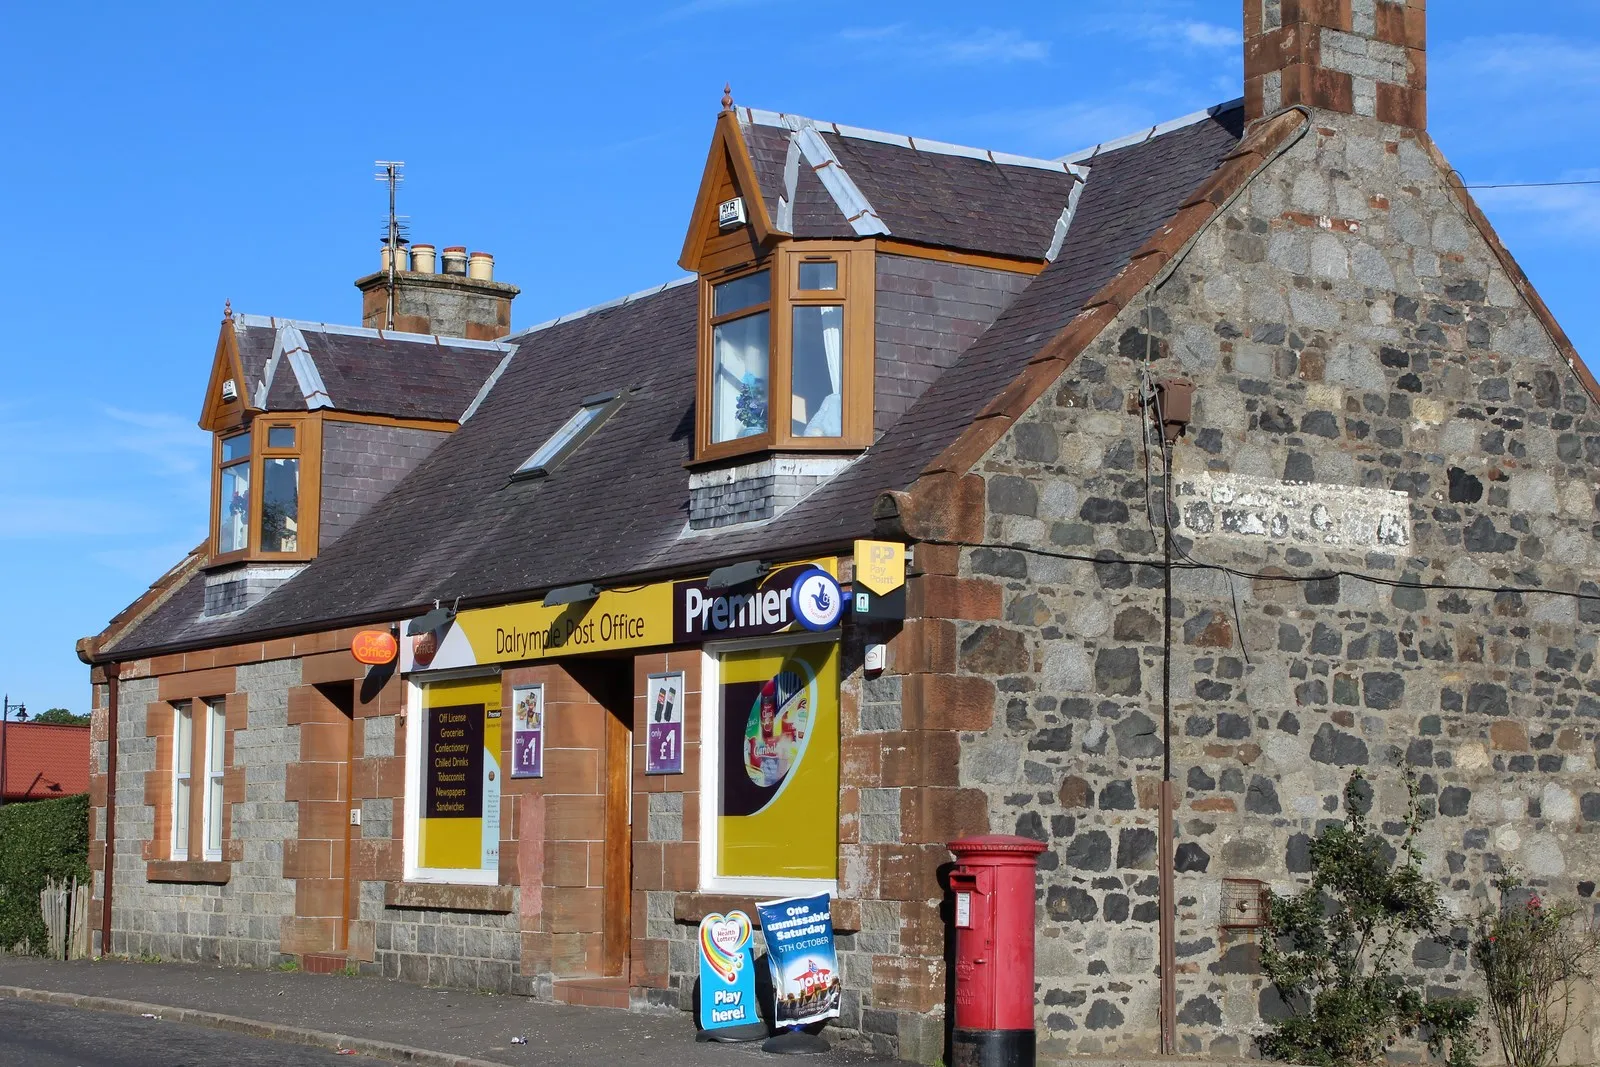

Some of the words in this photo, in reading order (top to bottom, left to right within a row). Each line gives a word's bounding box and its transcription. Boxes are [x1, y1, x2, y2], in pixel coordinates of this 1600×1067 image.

[722, 201, 735, 214] AYR
[686, 587, 792, 633] Premier
[496, 621, 561, 657] Dalrymple
[566, 618, 595, 646] Post
[600, 612, 645, 642] Office
[364, 635, 388, 647] Post
[358, 646, 392, 658] Office
[414, 643, 434, 655] OFFICE
[438, 714, 448, 723] Off
[440, 728, 464, 738] Groceries
[651, 728, 662, 739] only
[515, 735, 525, 747] only
[659, 729, 676, 760] £1
[522, 737, 536, 765] £1
[435, 758, 452, 767] Chilled
[453, 757, 469, 767] Drinks
[437, 772, 465, 782] Tobacconist
[436, 787, 466, 798] Newspapers
[436, 801, 464, 811] Sandwiches
[786, 905, 809, 916] One
[767, 912, 831, 932] unmissable
[776, 924, 826, 941] Saturday
[778, 943, 795, 953] 5TH
[796, 936, 829, 950] OCTOBER
[799, 972, 832, 989] lotto
[715, 990, 742, 1006] Play
[712, 1005, 745, 1023] here!
